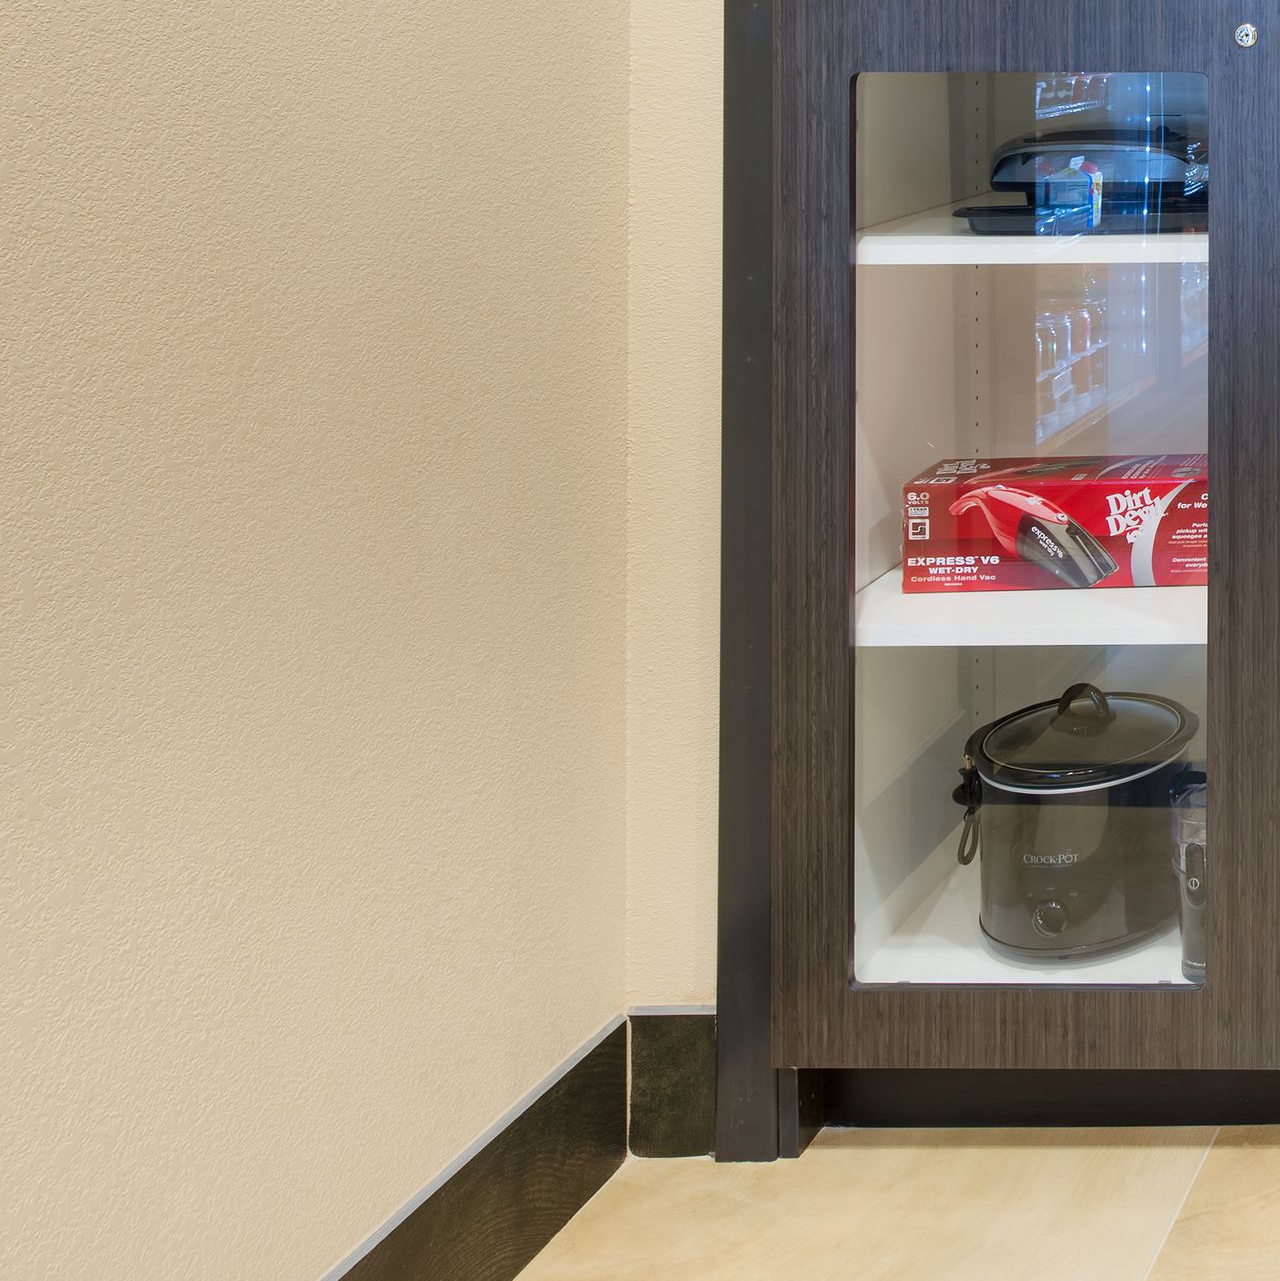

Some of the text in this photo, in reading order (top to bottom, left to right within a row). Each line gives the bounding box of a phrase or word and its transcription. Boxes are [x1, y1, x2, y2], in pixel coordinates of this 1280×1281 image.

[907, 492, 930, 500] 6.0
[1106, 487, 1152, 516] Dirt
[1031, 526, 1058, 552] express
[907, 556, 1000, 566] EXPRESS V6
[928, 566, 979, 574] WET-DRY
